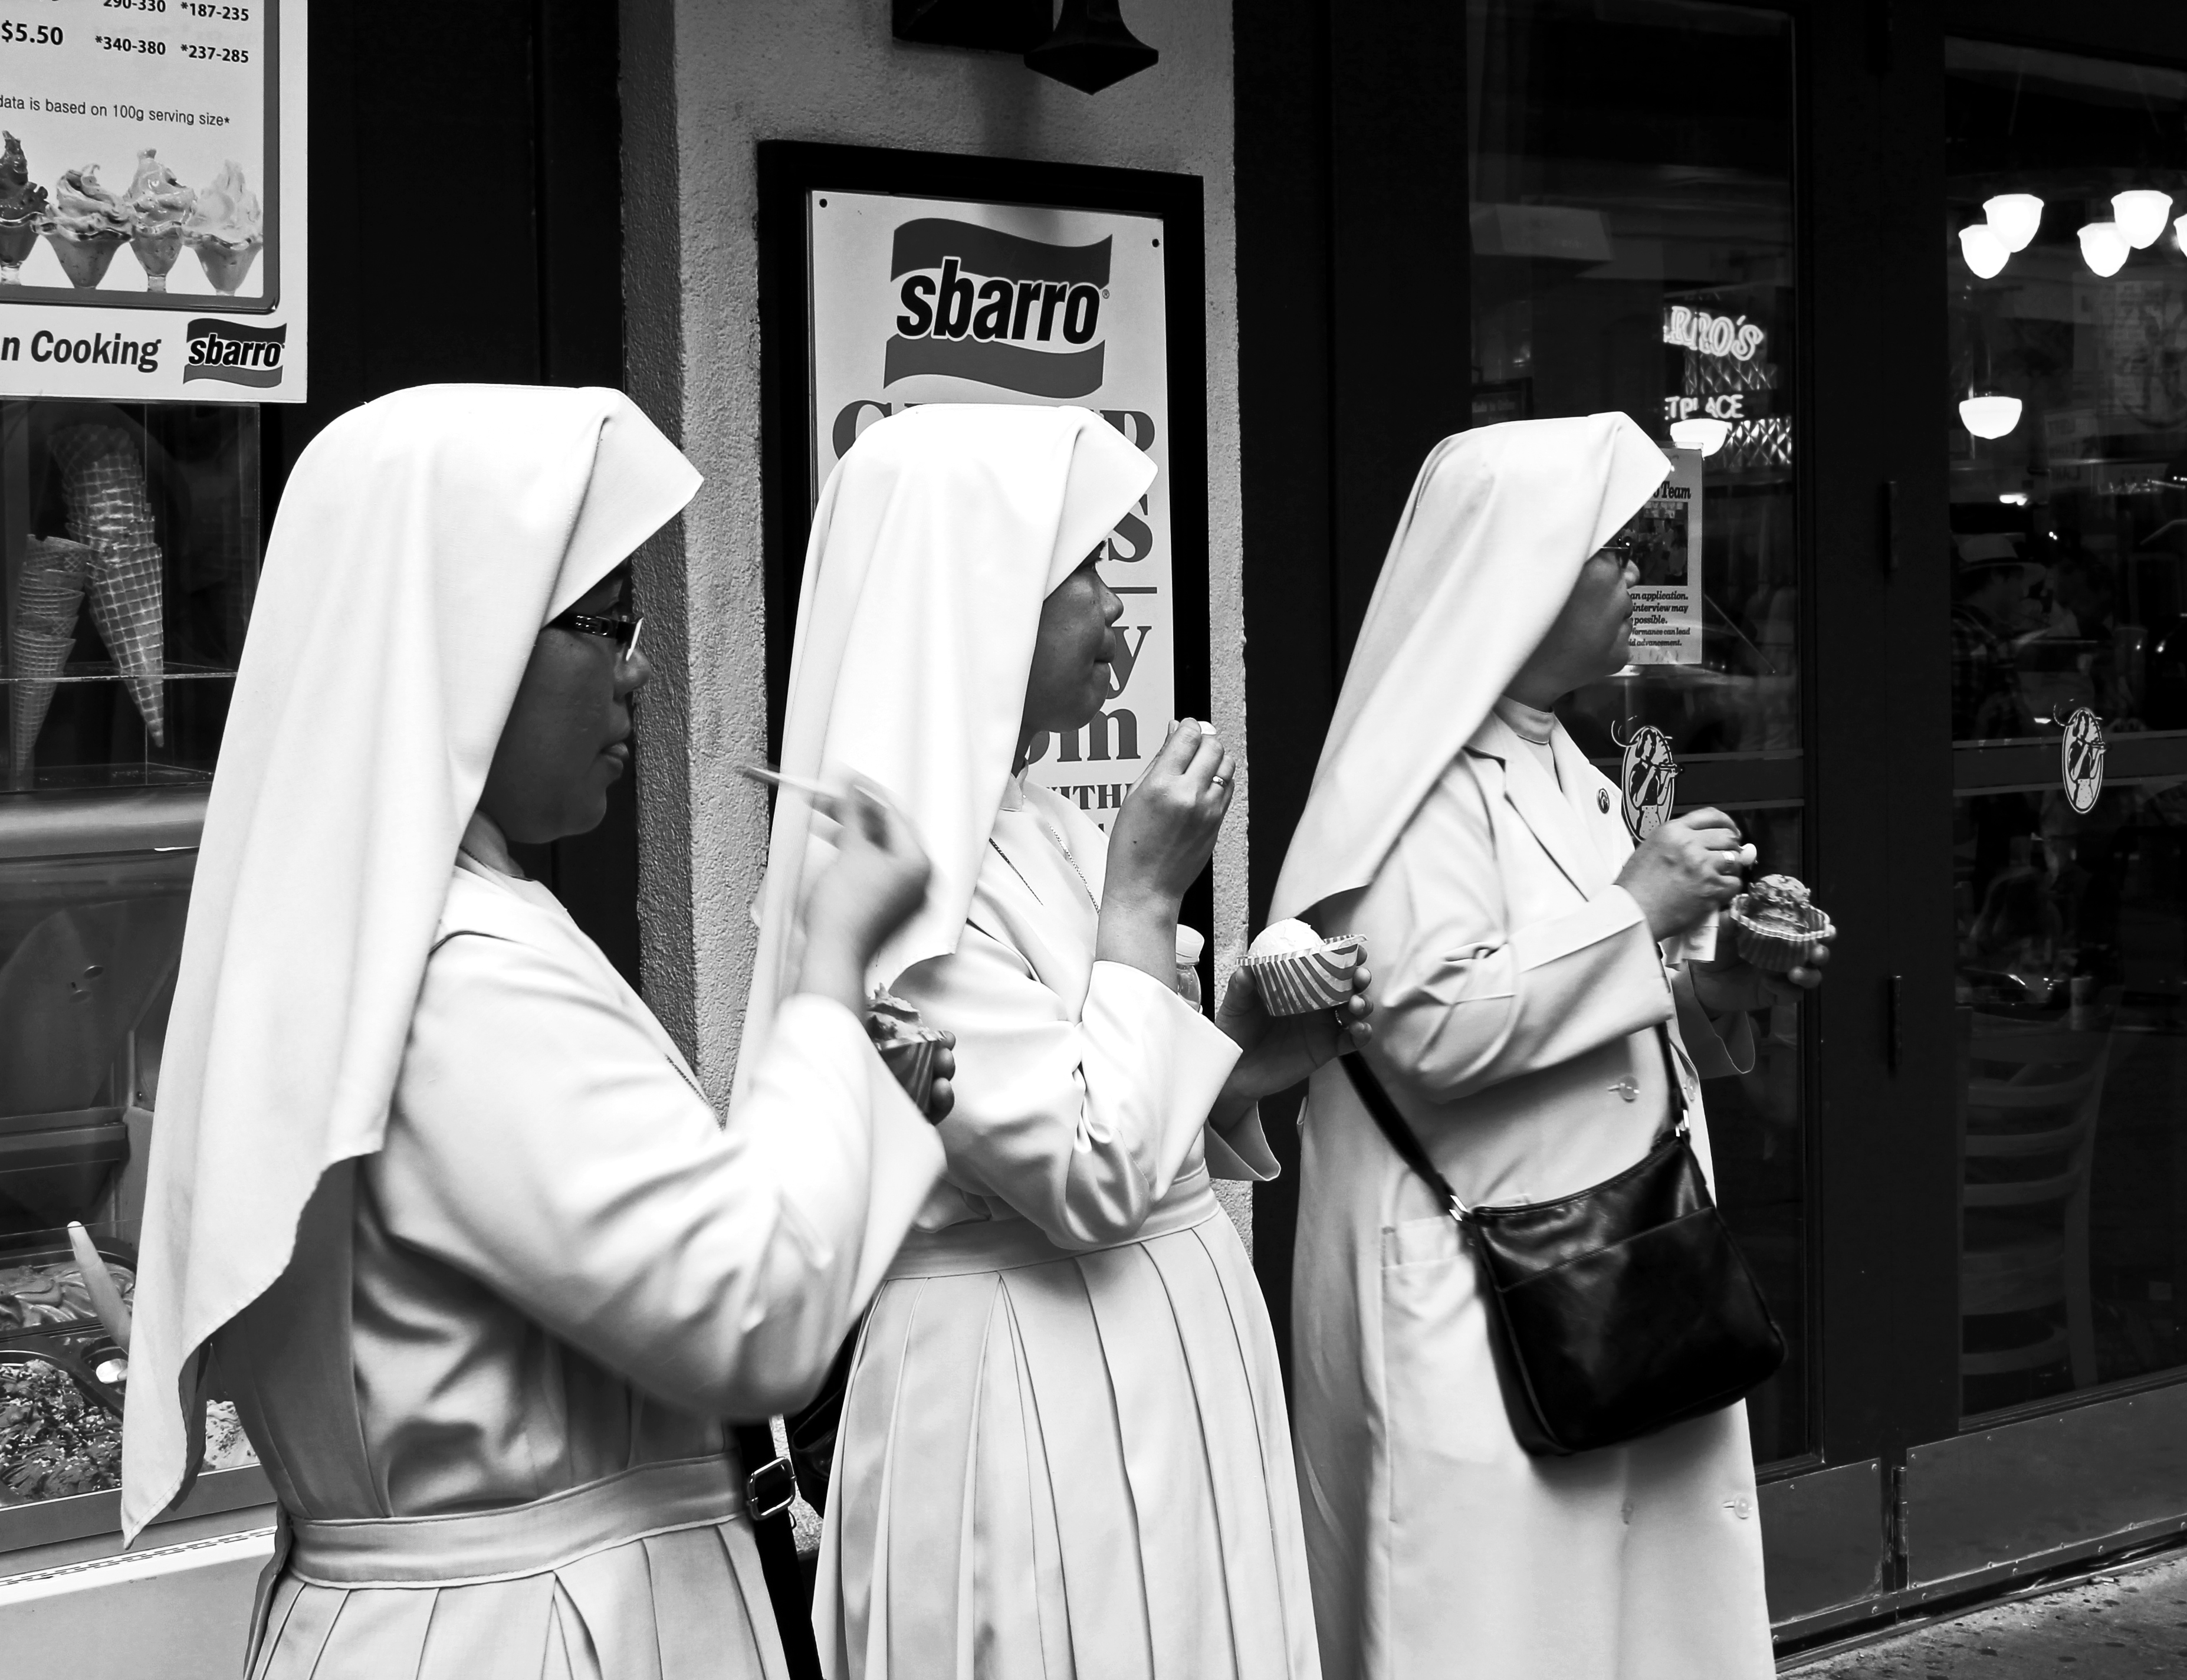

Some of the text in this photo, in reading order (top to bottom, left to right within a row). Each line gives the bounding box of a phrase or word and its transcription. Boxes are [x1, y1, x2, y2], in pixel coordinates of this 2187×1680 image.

[1, 19, 64, 45] $5.50
[29, 97, 41, 111] is
[45, 98, 86, 114] based
[90, 105, 107, 117] on
[113, 104, 144, 122] 100g
[149, 109, 194, 126] serving
[31, 330, 162, 373] Cooking
[188, 333, 281, 367] sbarro
[1661, 481, 1691, 499] Team
[1641, 590, 1689, 602] application.
[1633, 602, 1689, 614] interview may
[1634, 615, 1668, 626] possible.
[1676, 627, 1690, 635] lead
